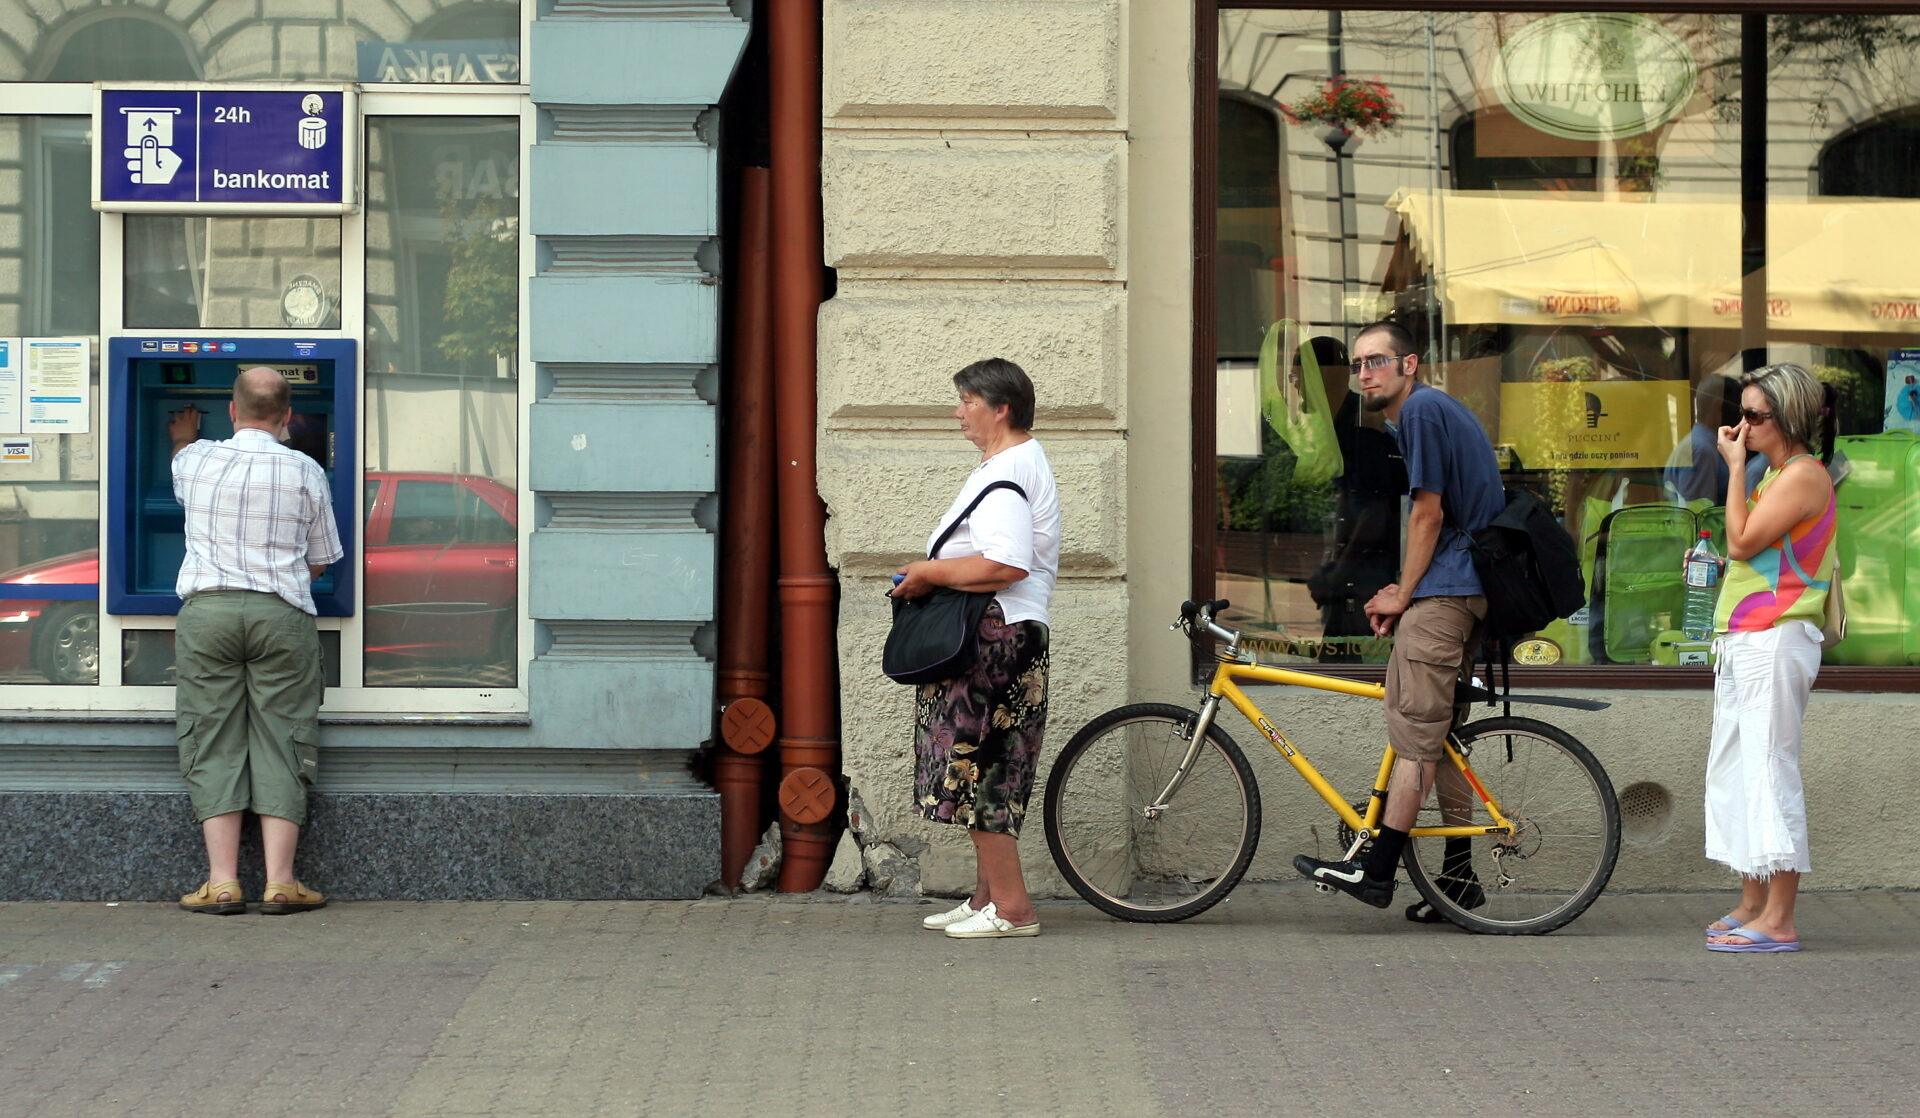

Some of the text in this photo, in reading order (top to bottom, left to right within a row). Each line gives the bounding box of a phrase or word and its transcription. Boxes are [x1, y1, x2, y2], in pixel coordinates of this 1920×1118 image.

[1525, 82, 1666, 103] WITTCHEN
[214, 106, 250, 123] 24h
[213, 168, 330, 189] bankomat
[1568, 435, 1618, 443] PUCCINI
[7, 447, 26, 455] VISA
[1590, 452, 1608, 461] oczy
